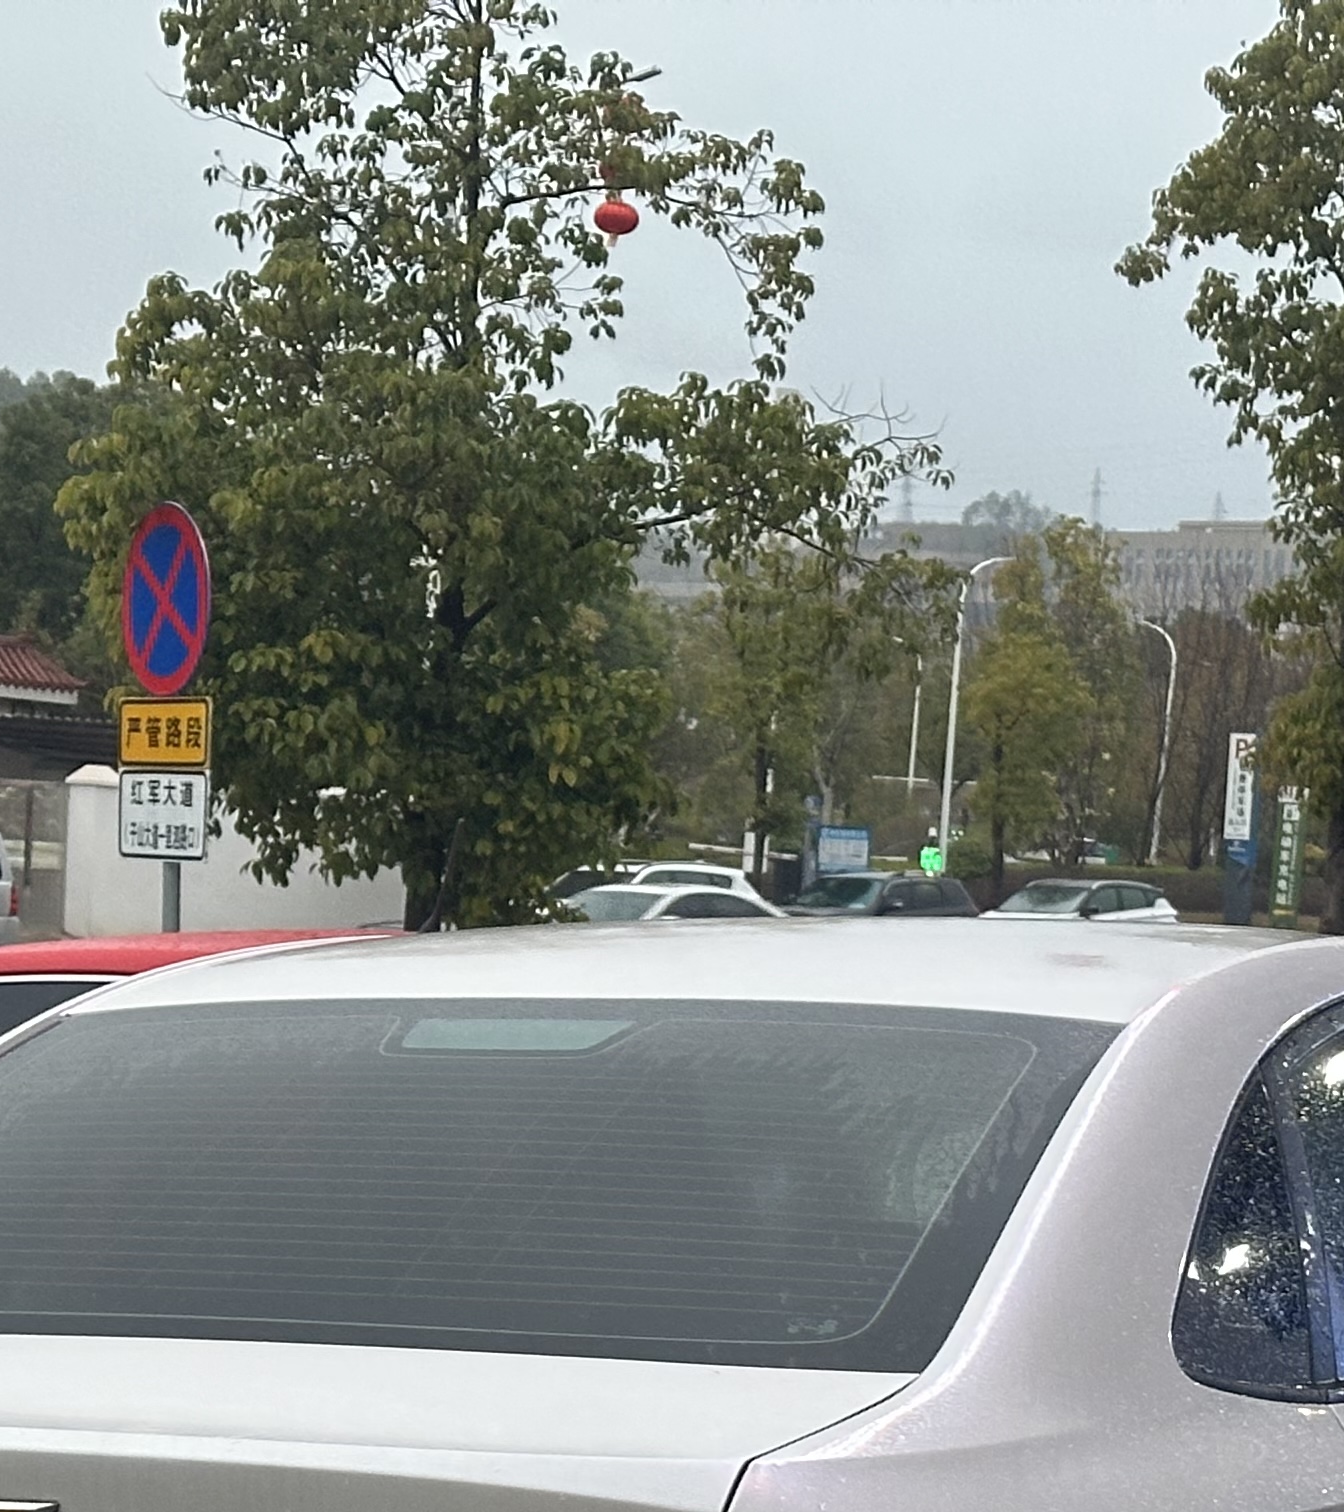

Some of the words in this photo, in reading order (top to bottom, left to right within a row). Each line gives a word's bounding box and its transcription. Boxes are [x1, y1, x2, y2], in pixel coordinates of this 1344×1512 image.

[126, 715, 203, 749] 严管路段
[130, 779, 194, 808] 红军大道
